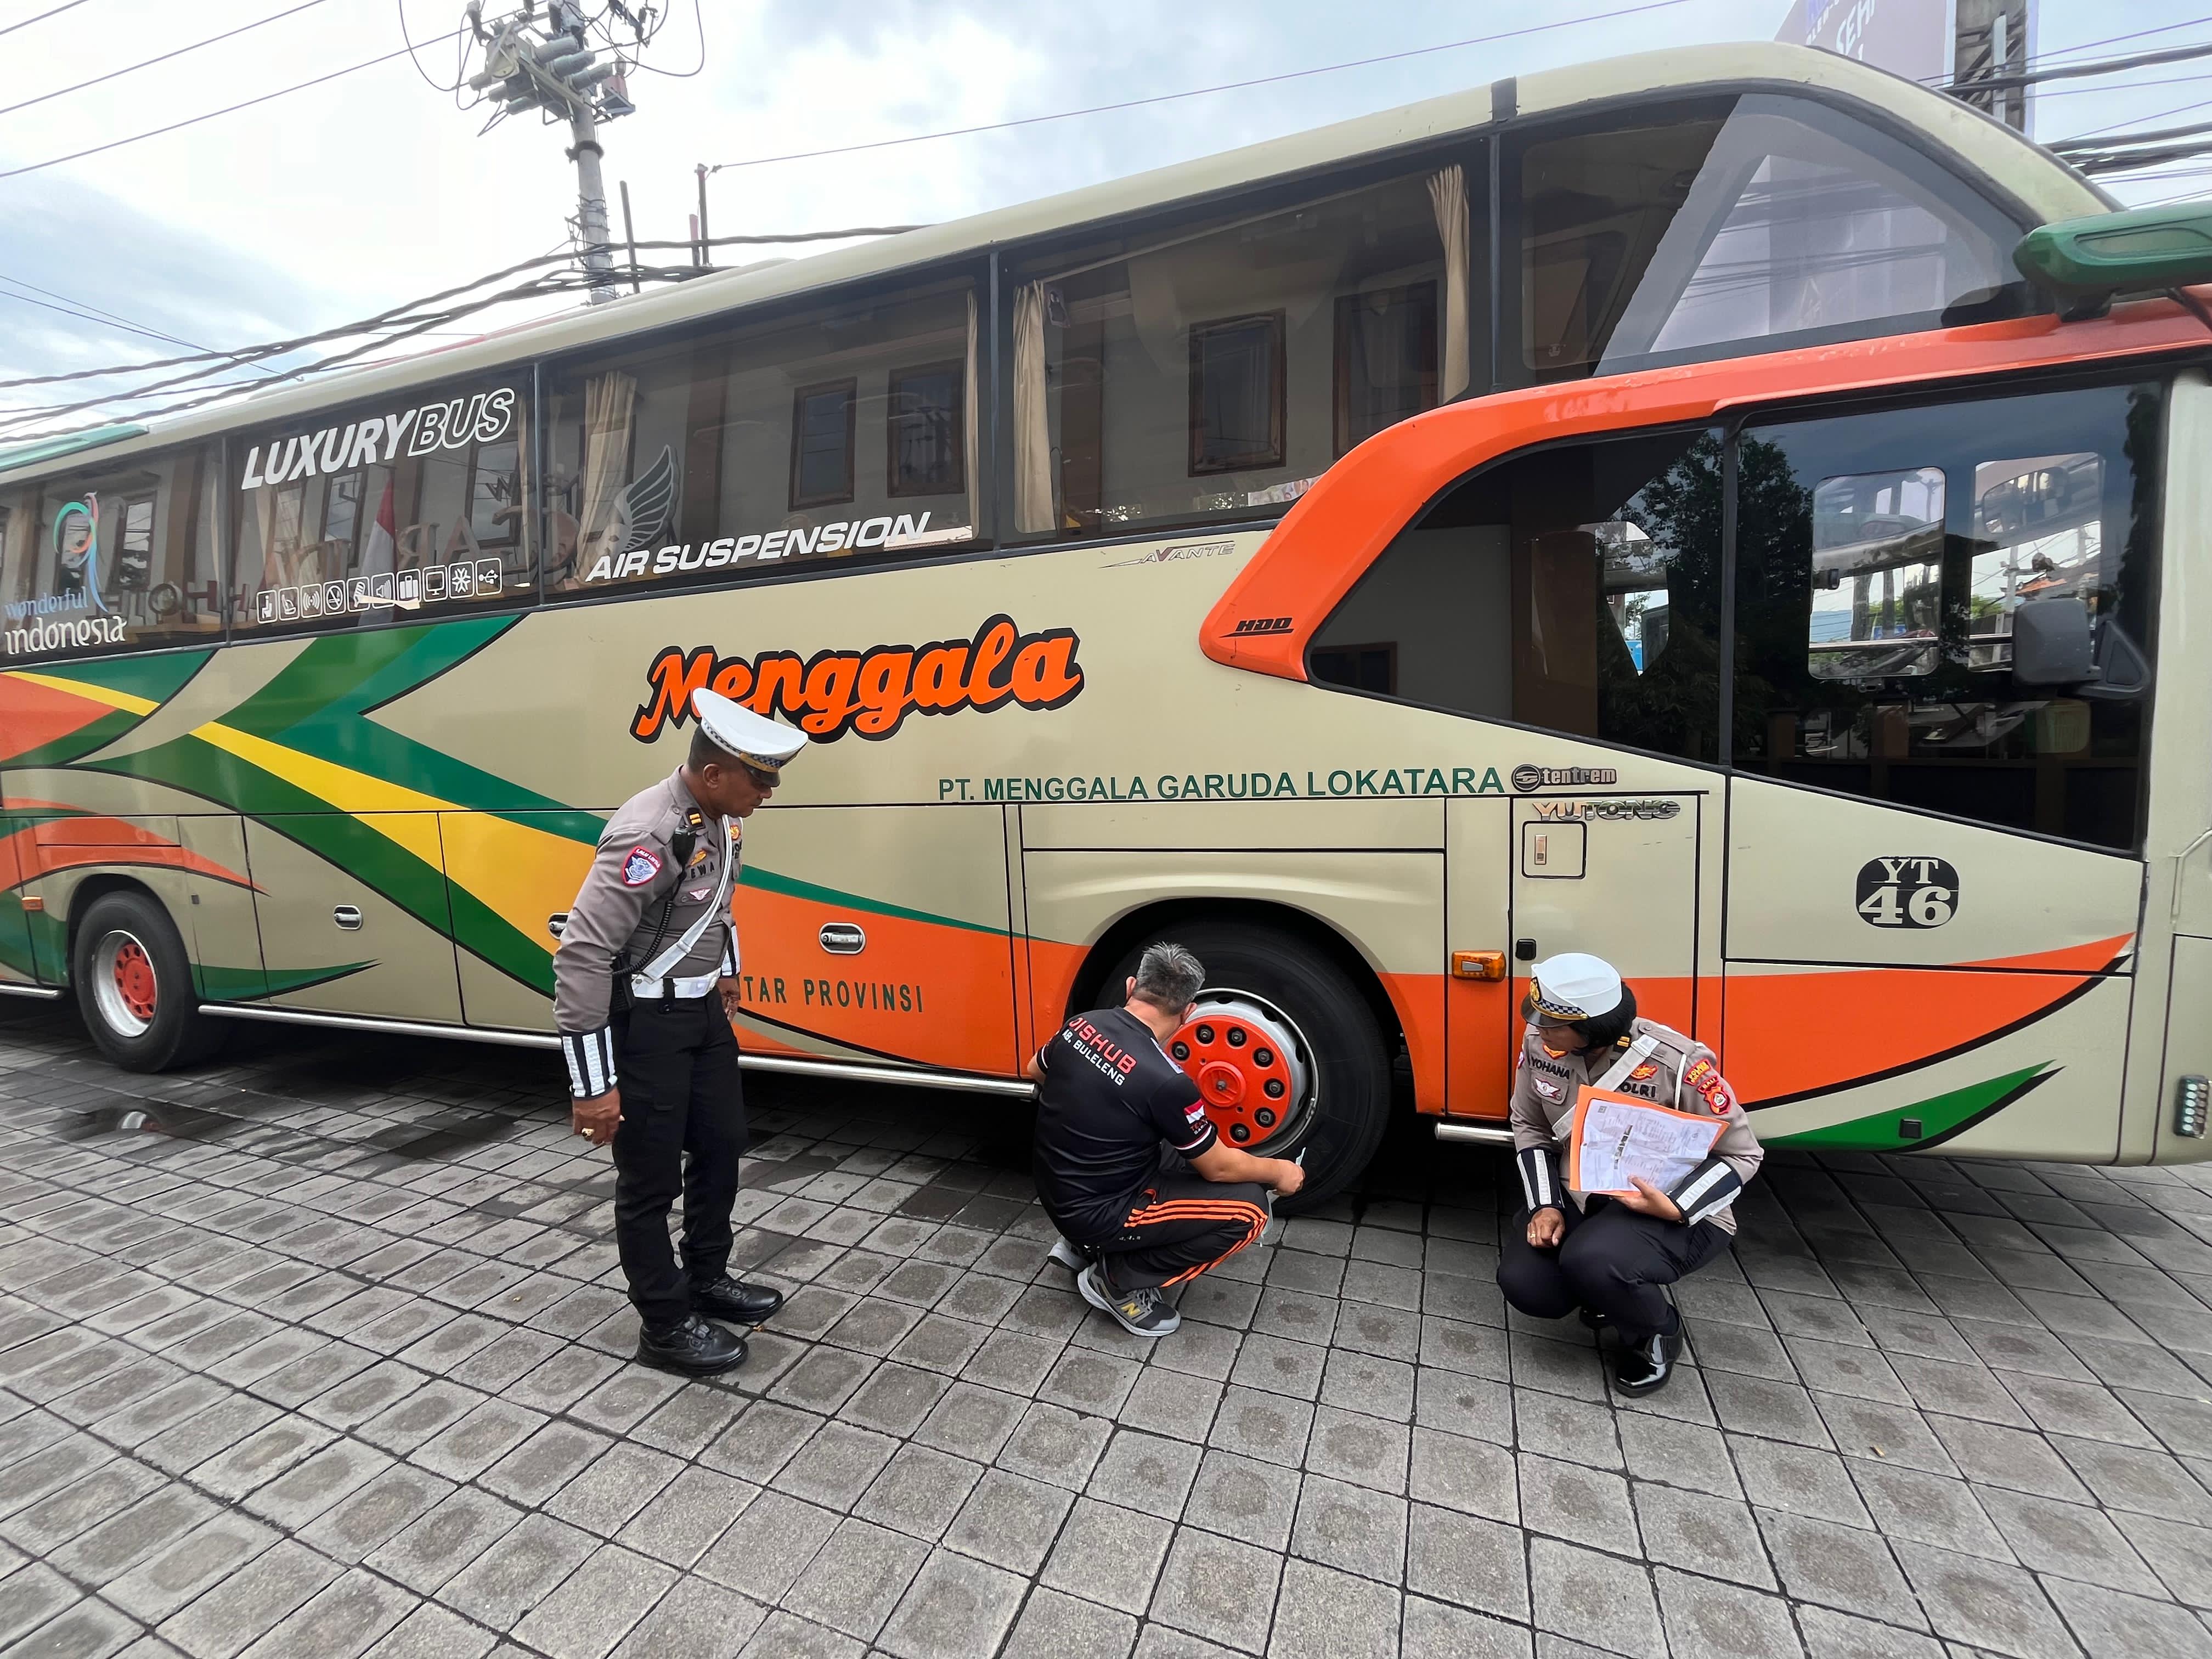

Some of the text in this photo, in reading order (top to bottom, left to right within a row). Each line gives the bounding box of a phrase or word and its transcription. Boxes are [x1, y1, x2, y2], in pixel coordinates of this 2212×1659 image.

[585, 511, 931, 582] AIR SUSPENSION
[1141, 544, 1235, 563] AVANTE
[5, 586, 88, 619] wonderful
[5, 616, 127, 654] indonesia
[631, 614, 1084, 743] Menggala
[939, 766, 1505, 800] PT. MENGGALA GARUDA LOKATARA
[1542, 768, 1616, 785] tentrem
[1532, 799, 1681, 821] YUTONG
[691, 861, 715, 879] EWA
[1878, 858, 1939, 884] YT
[1859, 886, 1951, 926] 46
[739, 976, 923, 1013] TAR PROVINSI
[1073, 1040, 1126, 1086] BULELENG
[1531, 1057, 1570, 1080] YOHANA
[1620, 1082, 1656, 1098] OLRI
